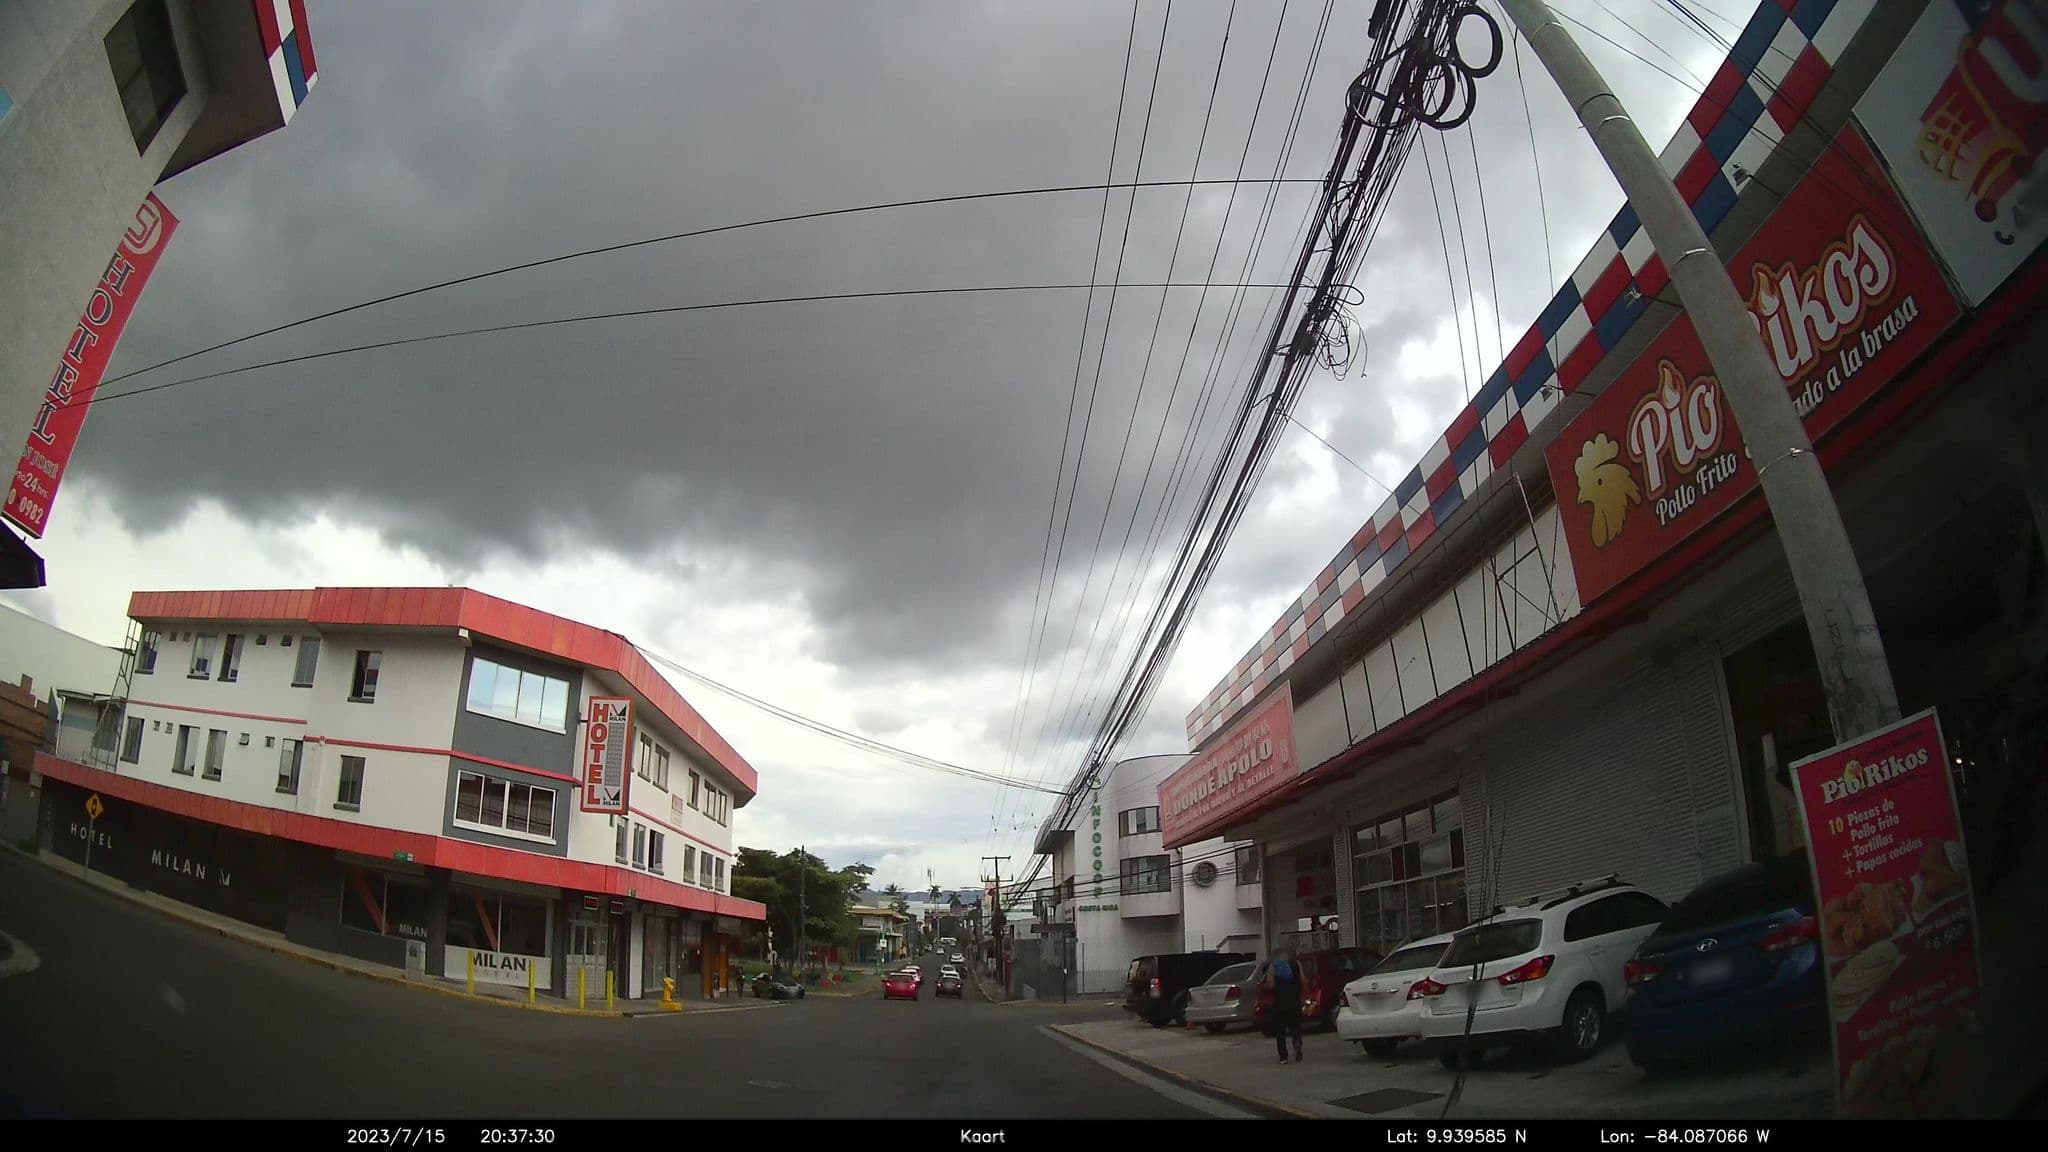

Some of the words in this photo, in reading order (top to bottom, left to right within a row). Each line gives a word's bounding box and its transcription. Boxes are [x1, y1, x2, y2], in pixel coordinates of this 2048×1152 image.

[32, 251, 136, 445] HOTEL
[1629, 366, 1720, 494] Pio
[1746, 220, 1893, 380] ikos
[1655, 483, 1696, 526] Pollo
[1695, 450, 1738, 496] Frito
[1825, 366, 1842, 392] a
[1839, 345, 1863, 379] la
[1861, 294, 1919, 359] brasa
[19, 496, 44, 525] 0982
[587, 703, 609, 805] HOTEL
[1173, 776, 1217, 817] DONDE
[1218, 738, 1273, 790] APOLO
[1246, 766, 1275, 788] DETALLE
[1819, 775, 1863, 805] Pio
[1862, 746, 1930, 789] Rikos
[1827, 817, 1845, 836] 10
[1847, 807, 1881, 828] Piezas
[1882, 797, 1896, 812] de
[1850, 825, 1877, 842] Pollo
[1877, 813, 1900, 832] frito
[70, 822, 113, 849] HOTEL
[1090, 791, 1104, 899] INFOCOOP
[1852, 833, 1895, 858] Tortillas
[151, 849, 207, 880] MILAN
[1855, 852, 1888, 874] Papas
[1078, 904, 1101, 912] COSTA
[399, 922, 428, 939] MILAN
[472, 951, 527, 972] MILAN
